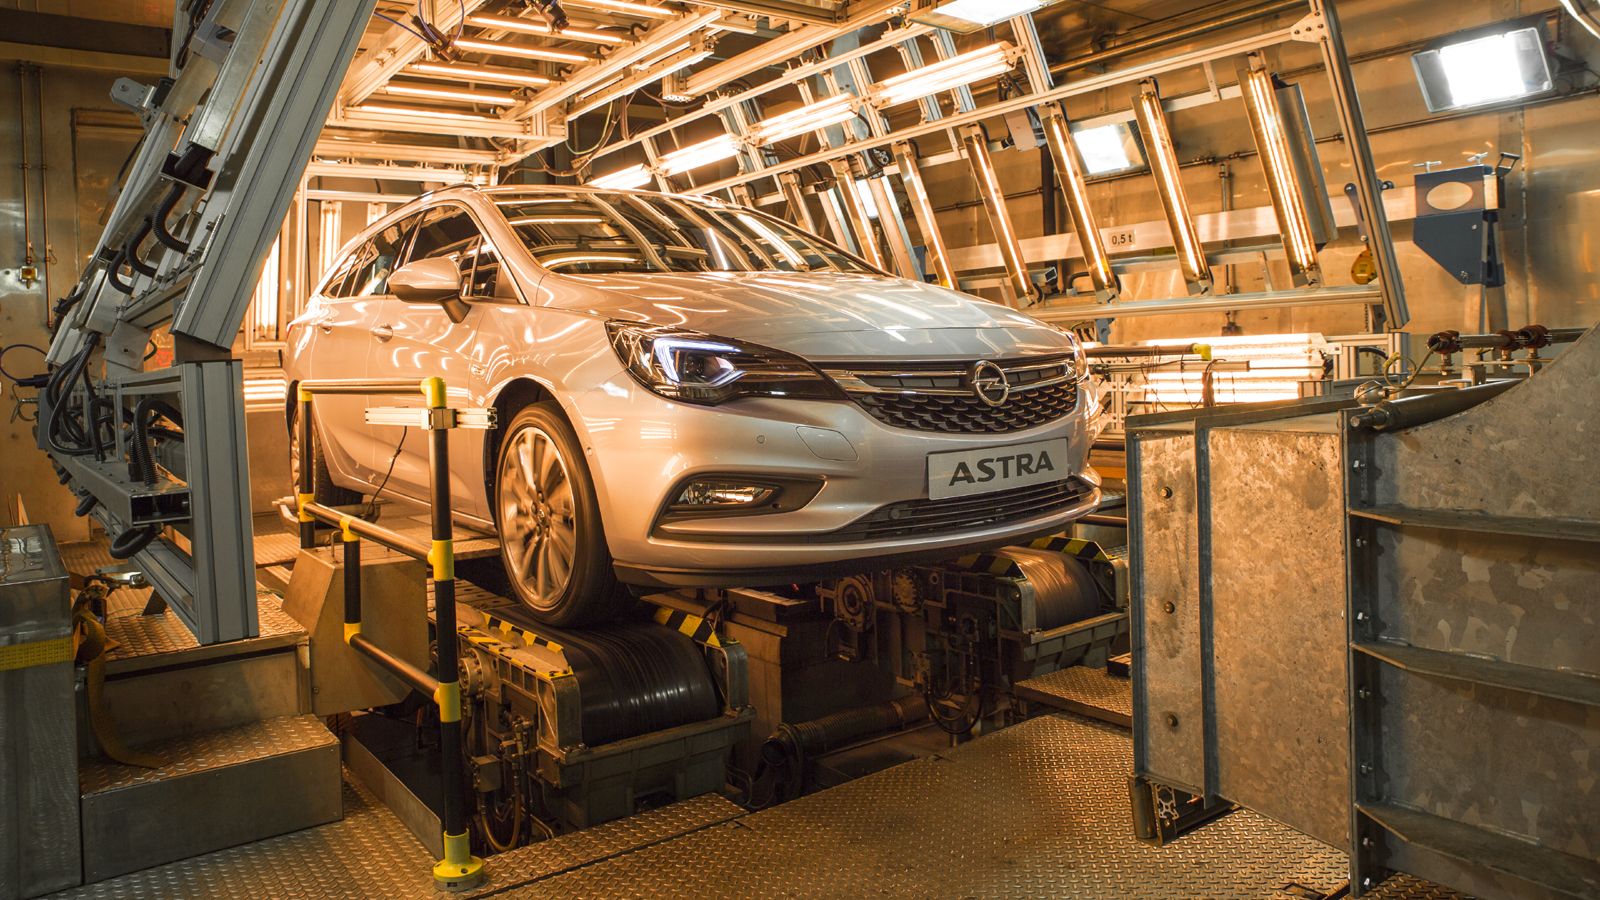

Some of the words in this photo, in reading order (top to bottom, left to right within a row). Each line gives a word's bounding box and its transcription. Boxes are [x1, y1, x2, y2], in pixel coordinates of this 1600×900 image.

[1111, 234, 1126, 245] 0,5
[1128, 233, 1133, 243] t
[949, 451, 1054, 486] ASTRA
